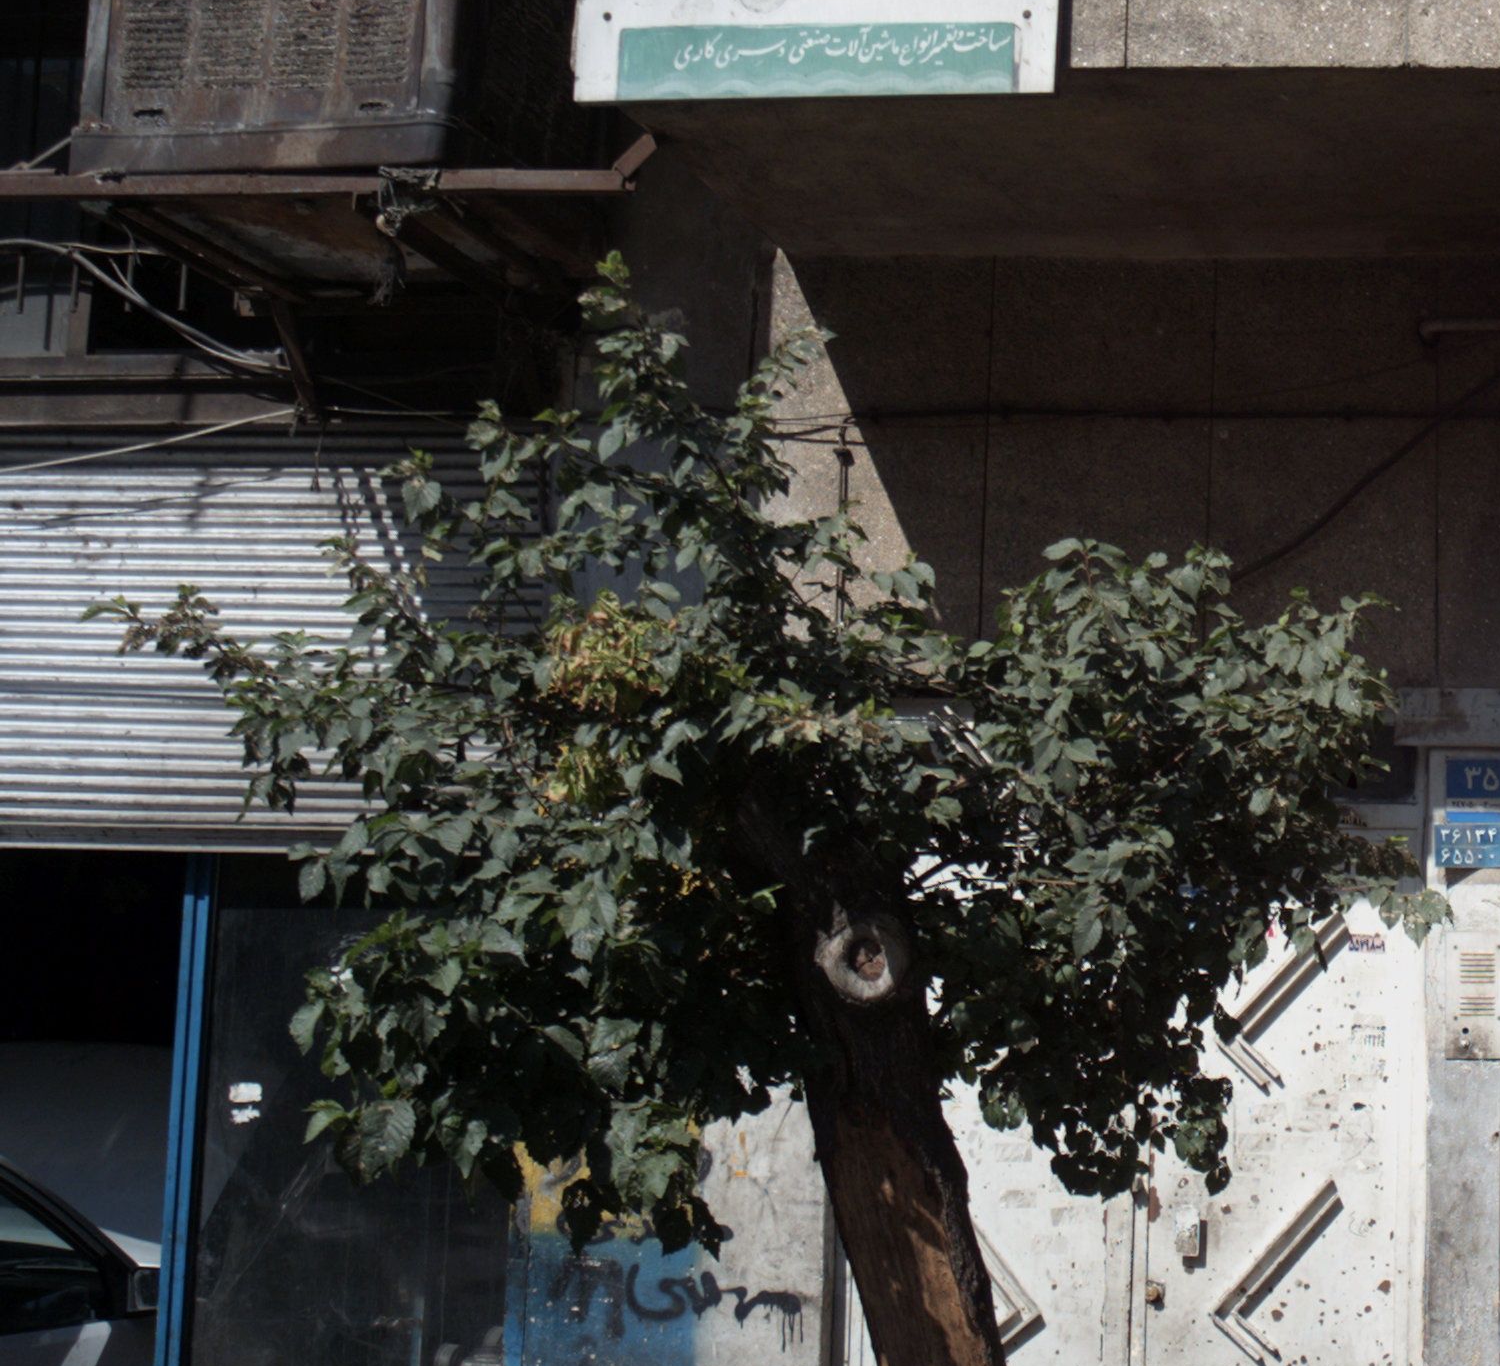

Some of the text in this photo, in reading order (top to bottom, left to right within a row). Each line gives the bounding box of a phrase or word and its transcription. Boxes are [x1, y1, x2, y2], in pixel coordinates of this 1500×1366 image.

[673, 32, 724, 71] کاری
[788, 30, 831, 65] صنعتی
[825, 26, 873, 58] آلات
[858, 30, 899, 64] ماشین
[898, 26, 939, 67] انواع
[918, 25, 960, 66] تعمیر
[952, 28, 1012, 53] ساخت
[1463, 765, 1500, 792] ۳۵
